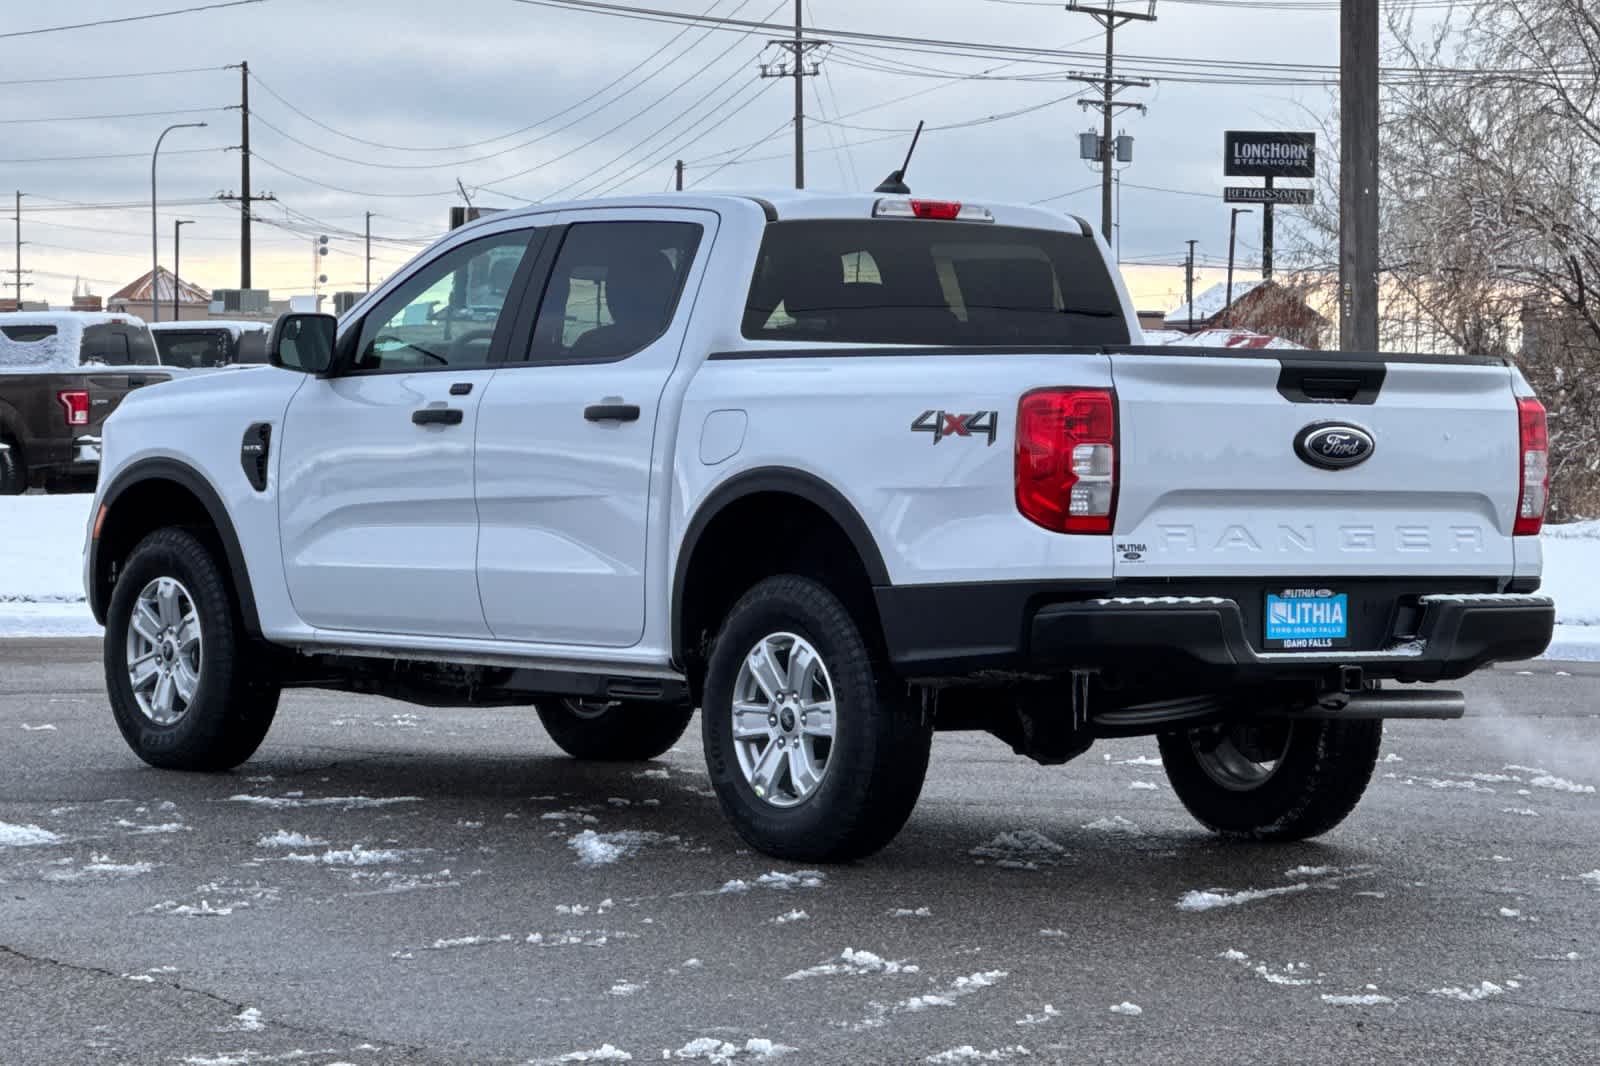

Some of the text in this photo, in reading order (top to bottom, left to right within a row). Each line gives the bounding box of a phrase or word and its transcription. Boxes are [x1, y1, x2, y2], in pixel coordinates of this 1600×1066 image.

[1234, 142, 1308, 159] LONGHORN
[1323, 434, 1359, 455] Ford
[1156, 524, 1484, 552] RANGER
[1124, 544, 1148, 552] LITHIA
[1287, 602, 1343, 624] LITHIA
[1283, 638, 1333, 649] IDAHO FALLS
